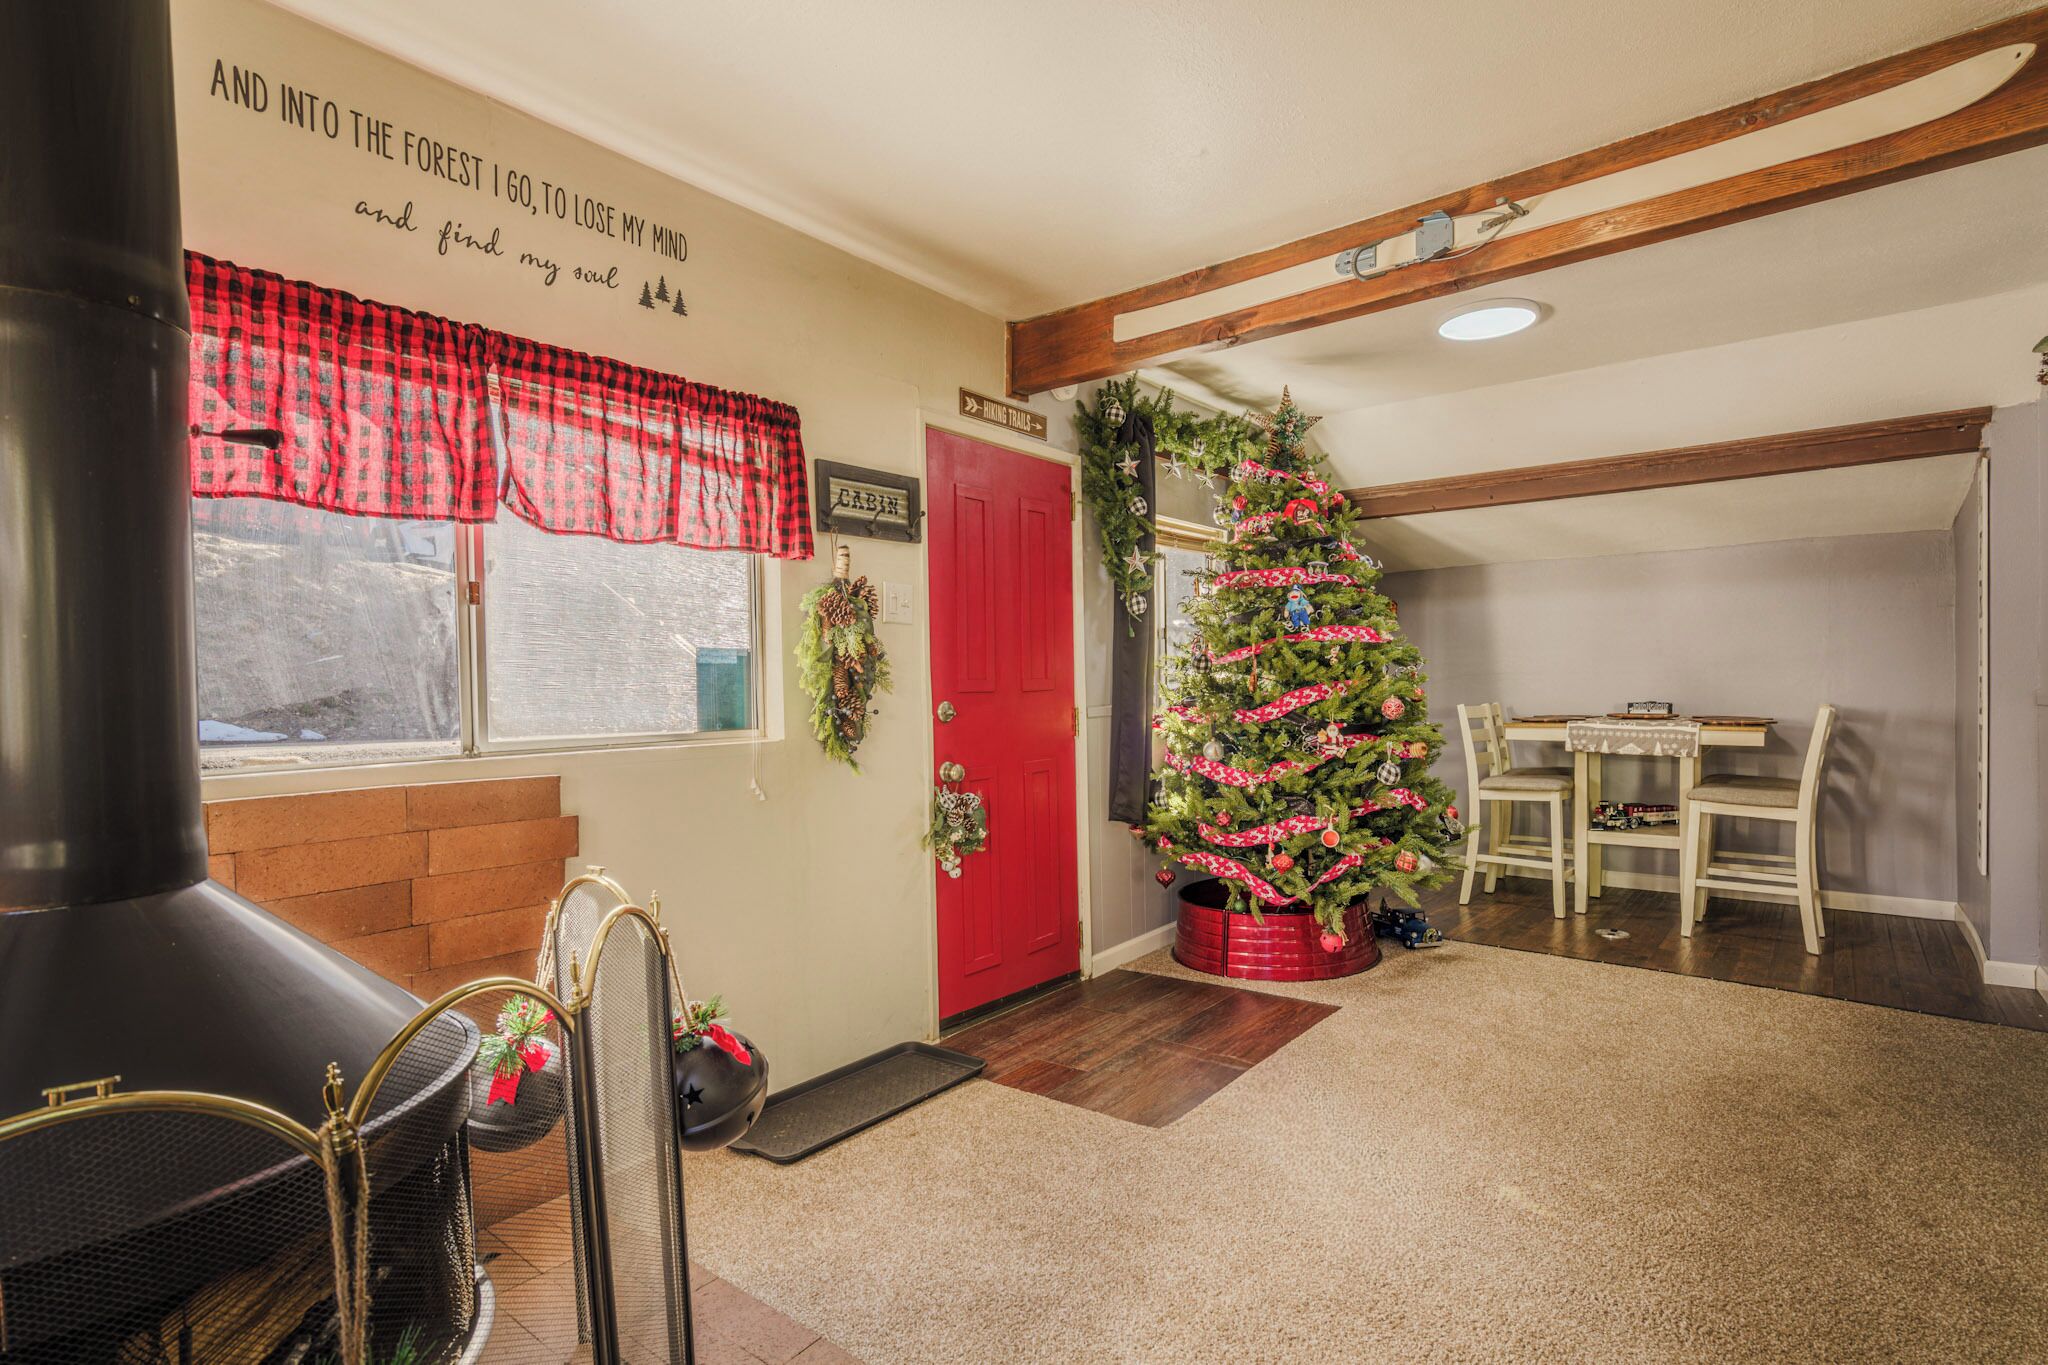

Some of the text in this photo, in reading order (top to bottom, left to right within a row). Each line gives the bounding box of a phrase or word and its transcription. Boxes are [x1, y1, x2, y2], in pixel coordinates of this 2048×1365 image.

[211, 59, 688, 263] AND INTO THE FOREST I GO, TO LOSE MY MIND
[355, 201, 619, 289] and find my soul
[983, 400, 1031, 432] HIKING TRAILS
[838, 488, 898, 515] CABIN
